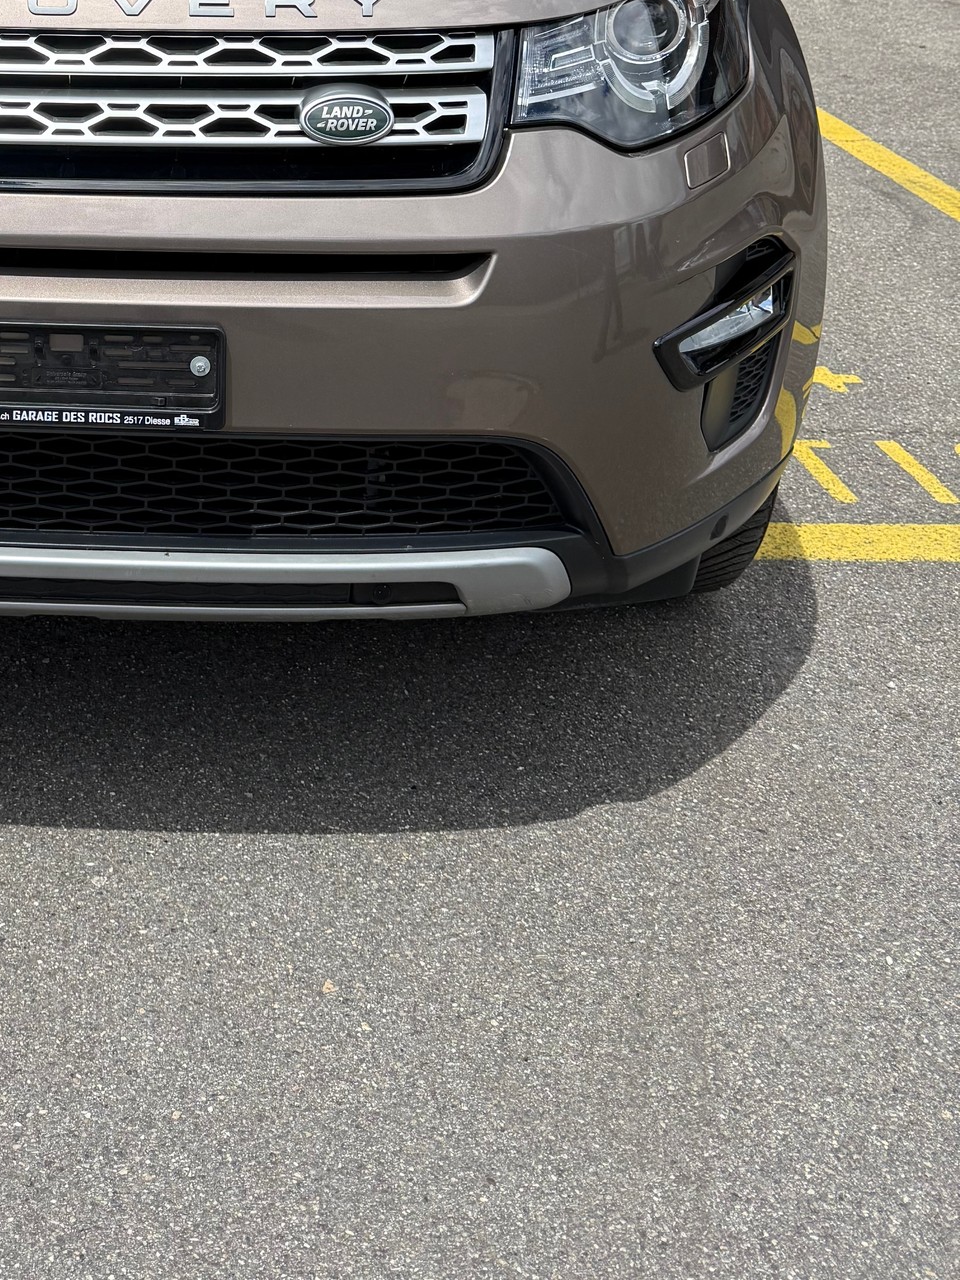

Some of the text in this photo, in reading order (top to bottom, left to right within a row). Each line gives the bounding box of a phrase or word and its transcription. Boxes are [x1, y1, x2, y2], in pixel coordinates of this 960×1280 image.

[321, 106, 364, 119] LAND
[325, 118, 377, 131] ROVER
[12, 410, 59, 422] GARAGE
[62, 411, 85, 423] DES
[88, 412, 121, 424] ROCS
[123, 415, 144, 425] 2517
[144, 416, 171, 426] Diesse
